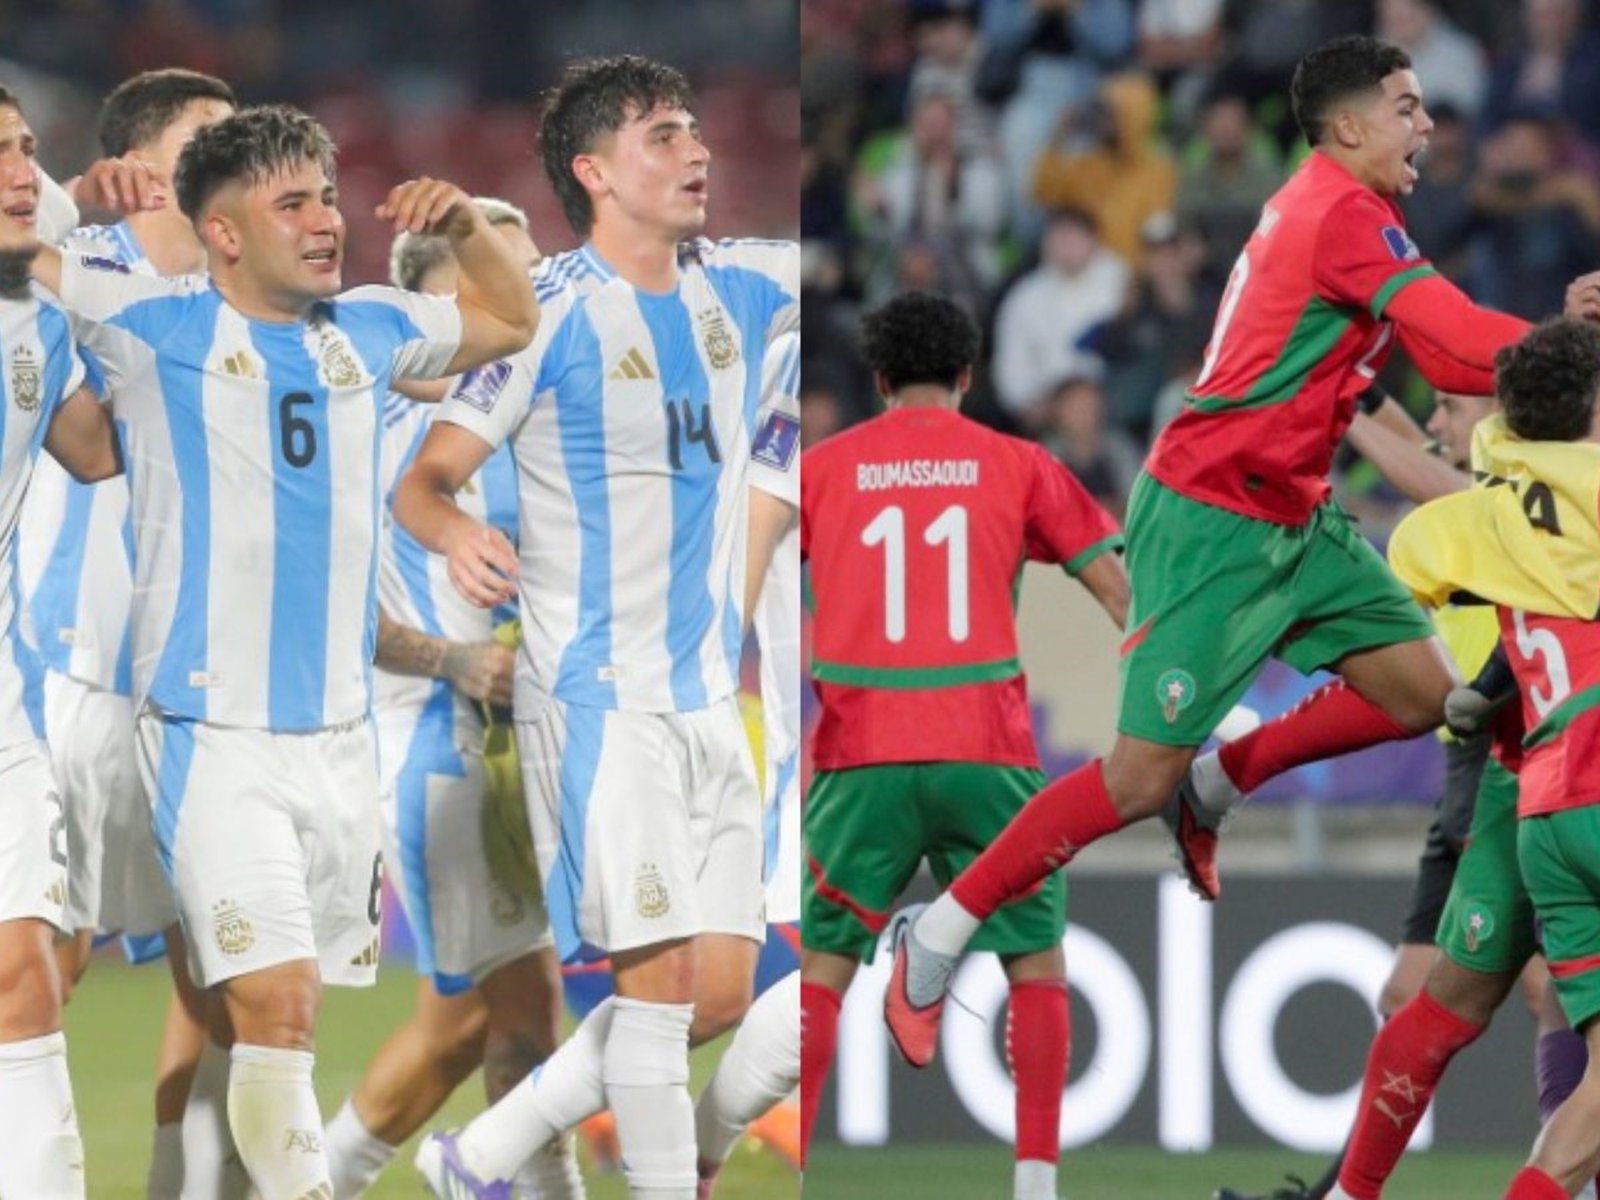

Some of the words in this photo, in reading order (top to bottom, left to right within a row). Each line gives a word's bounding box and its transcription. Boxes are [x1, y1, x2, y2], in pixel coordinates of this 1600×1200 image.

[279, 392, 317, 468] 6
[666, 398, 721, 470] 14
[860, 504, 969, 643] 11
